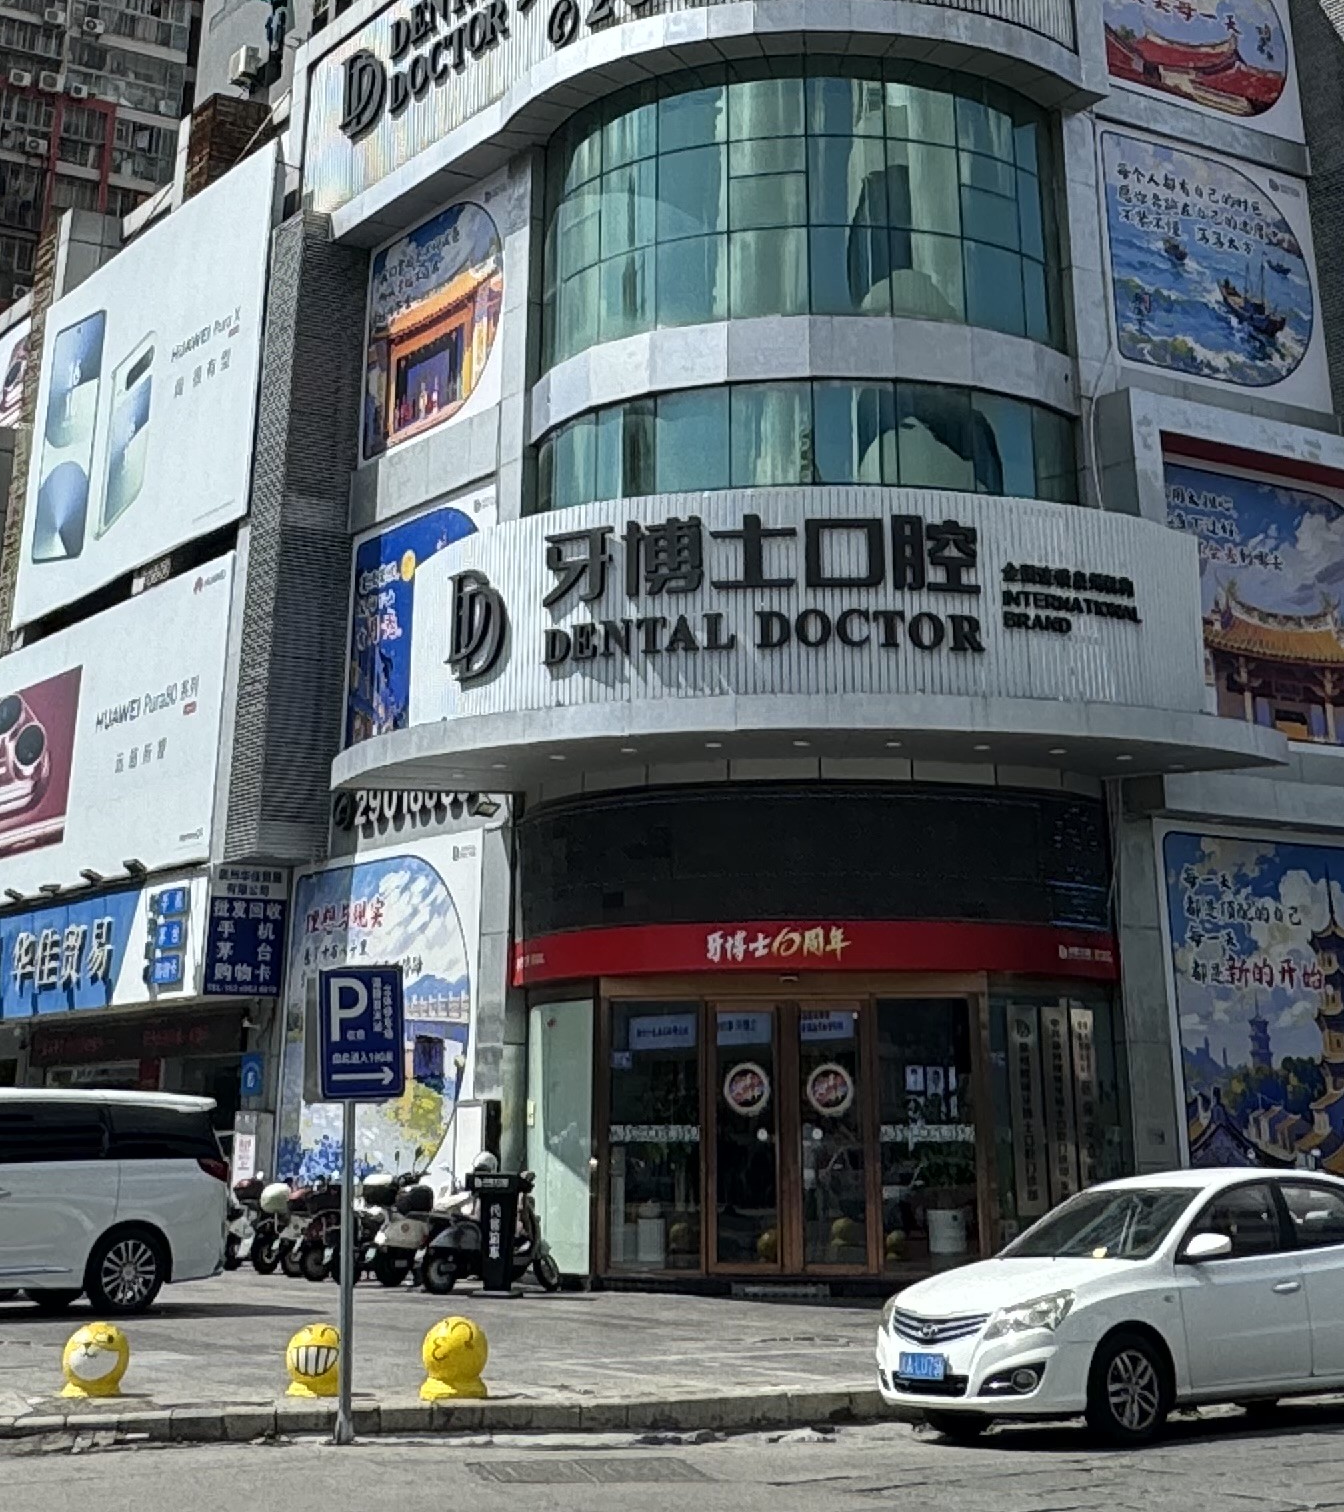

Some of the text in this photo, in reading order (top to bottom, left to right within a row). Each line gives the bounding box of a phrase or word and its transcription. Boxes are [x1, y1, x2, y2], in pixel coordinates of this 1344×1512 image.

[542, 514, 982, 610] 牙博士口腔
[1002, 590, 1143, 623] INTERNATIONAL
[1003, 610, 1072, 633] BRAND
[543, 607, 986, 668] DENTAL DOCTOR
[95, 699, 142, 732] HUAWEI
[12, 917, 114, 994] 华佳贸易
[214, 963, 272, 983] 购物卡
[330, 977, 368, 1043] P
